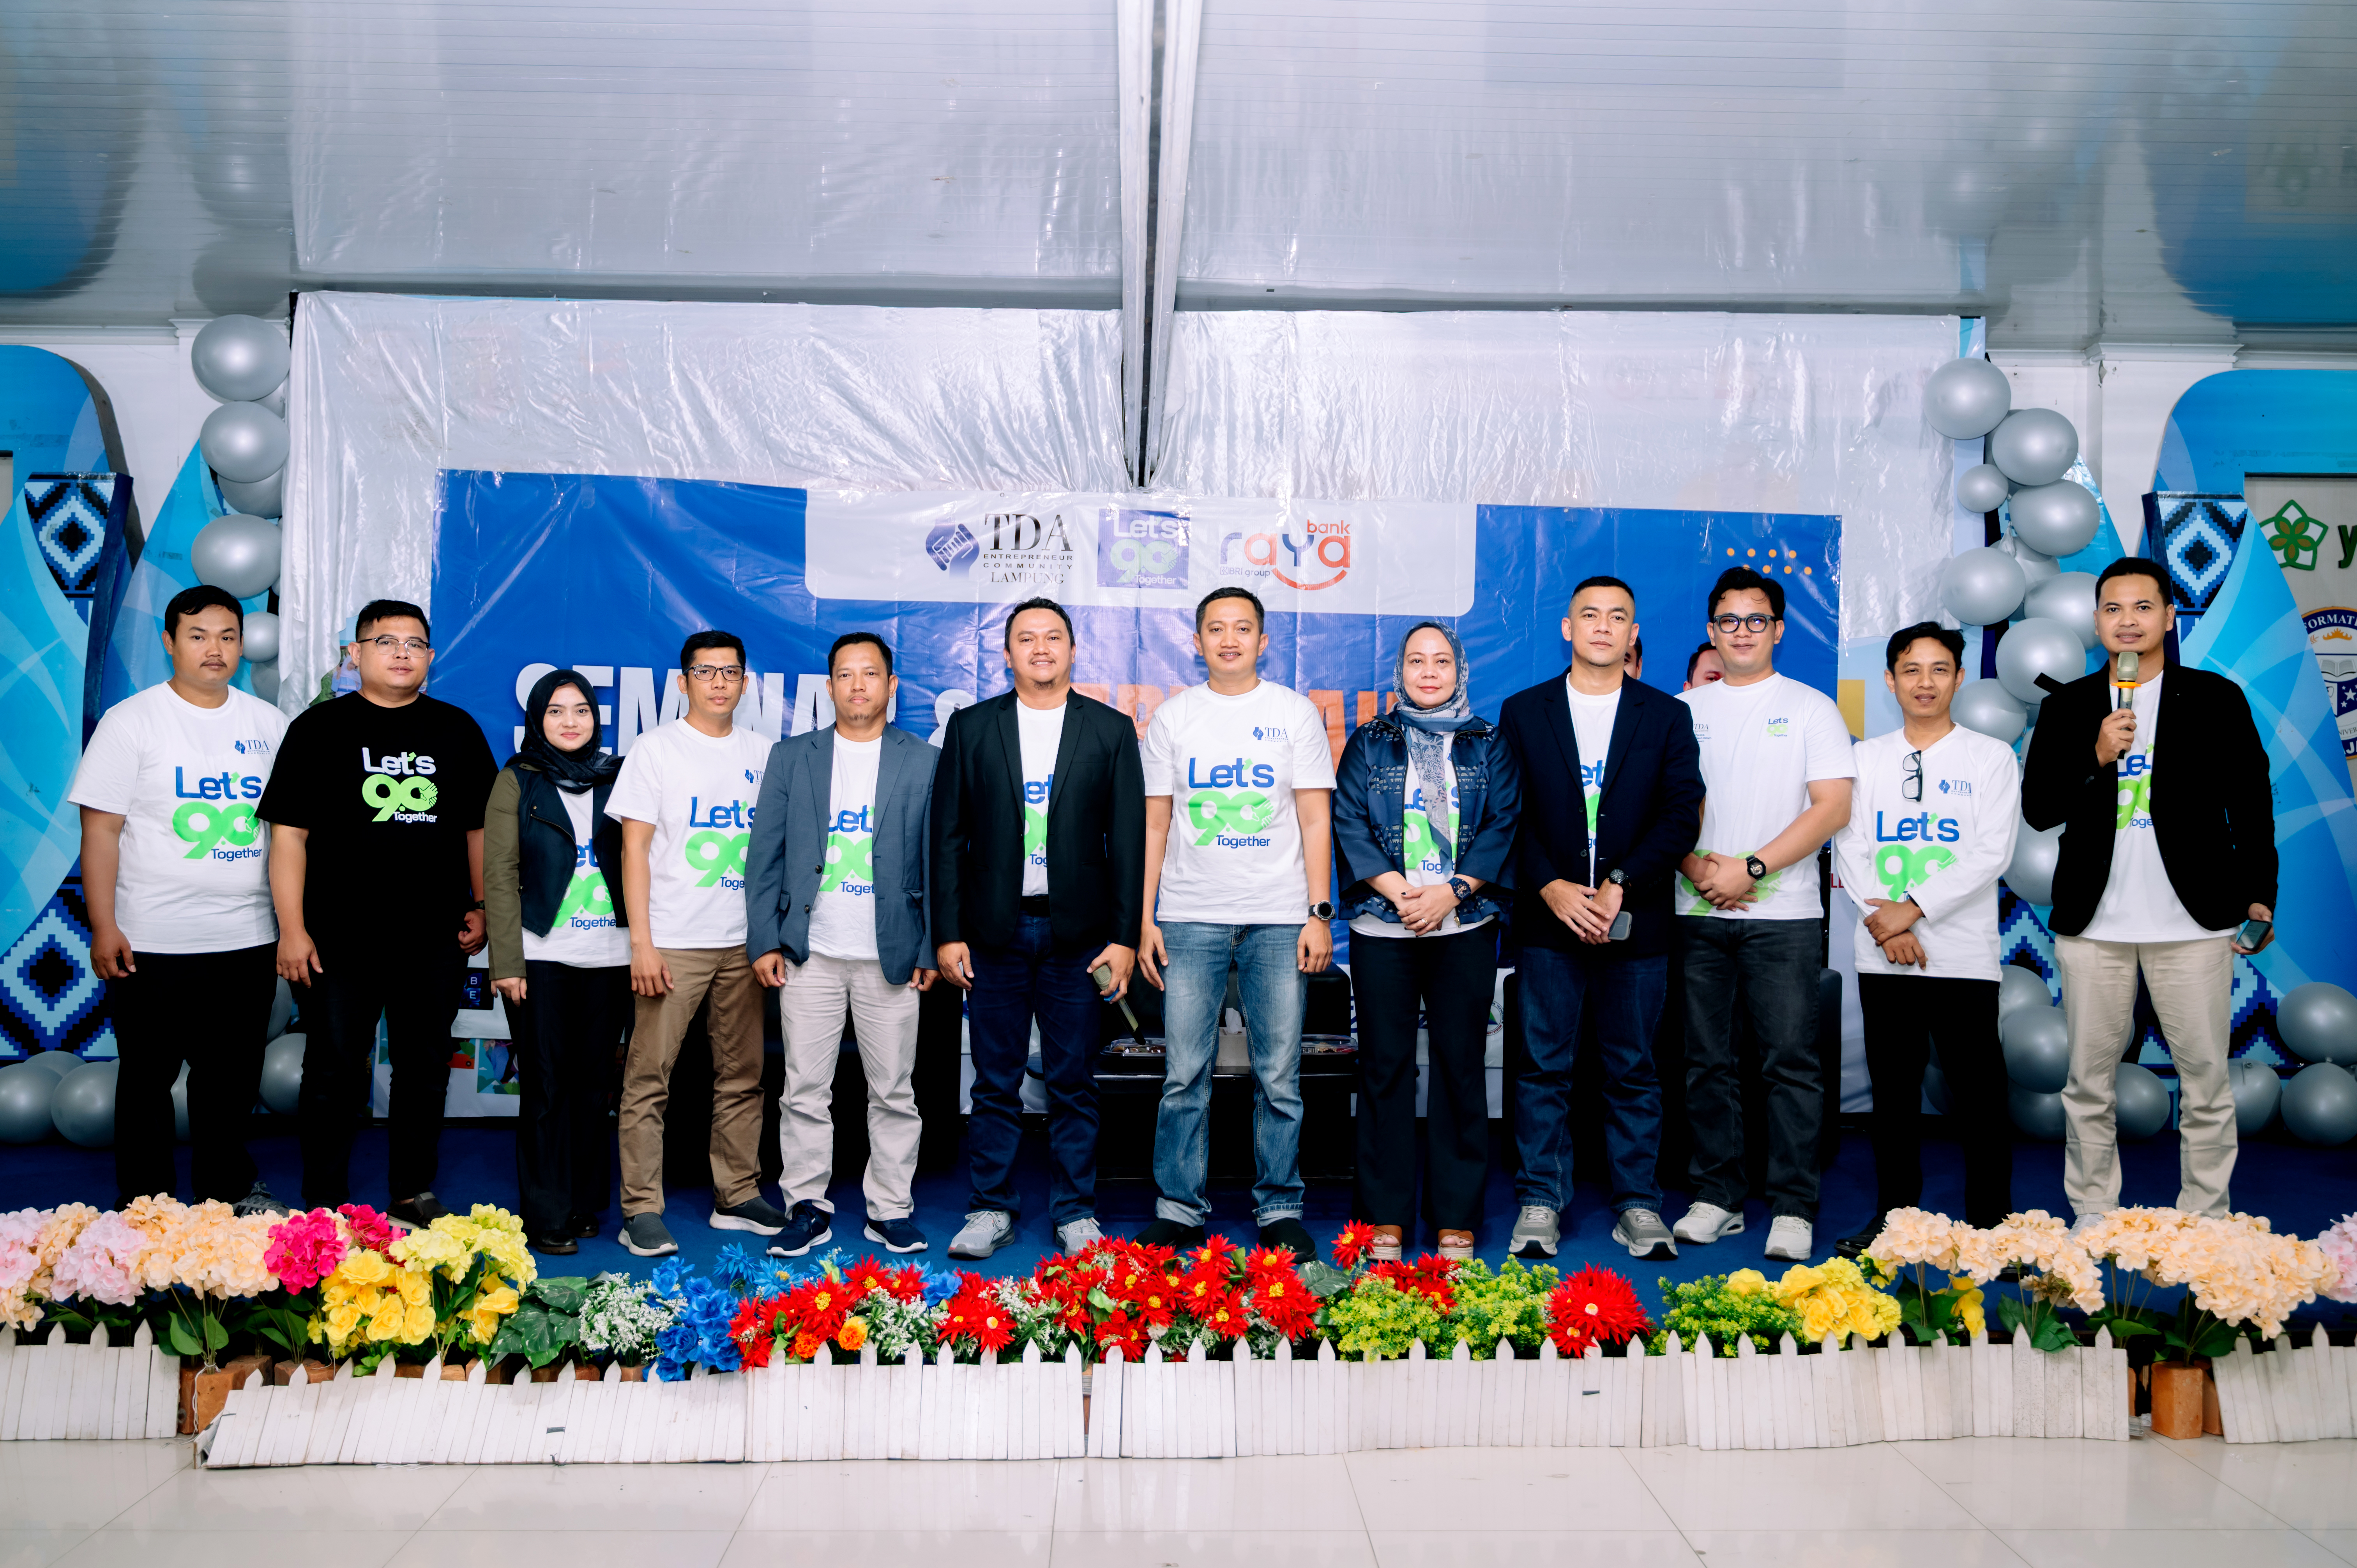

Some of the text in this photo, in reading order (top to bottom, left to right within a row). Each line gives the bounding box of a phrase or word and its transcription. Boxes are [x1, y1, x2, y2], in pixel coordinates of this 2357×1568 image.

[985, 513, 1073, 551] TDA
[1113, 515, 1178, 539] Let's
[1307, 519, 1351, 534] bank
[990, 572, 1064, 584] LAMPUNG
[1135, 574, 1177, 585] Together
[1245, 569, 1270, 578] group
[1265, 727, 1288, 738] TDA
[245, 740, 269, 750] TDA
[362, 747, 436, 775] Let's
[754, 770, 765, 780] TD
[1188, 758, 1274, 789] Let's
[175, 766, 262, 800] Let's
[393, 811, 437, 823] Together
[1876, 810, 1960, 842] Let's
[1216, 835, 1271, 849] Together
[211, 847, 262, 862] Together
[840, 881, 875, 896] Toget
[569, 914, 617, 931] Togethe
[470, 991, 476, 999] E
